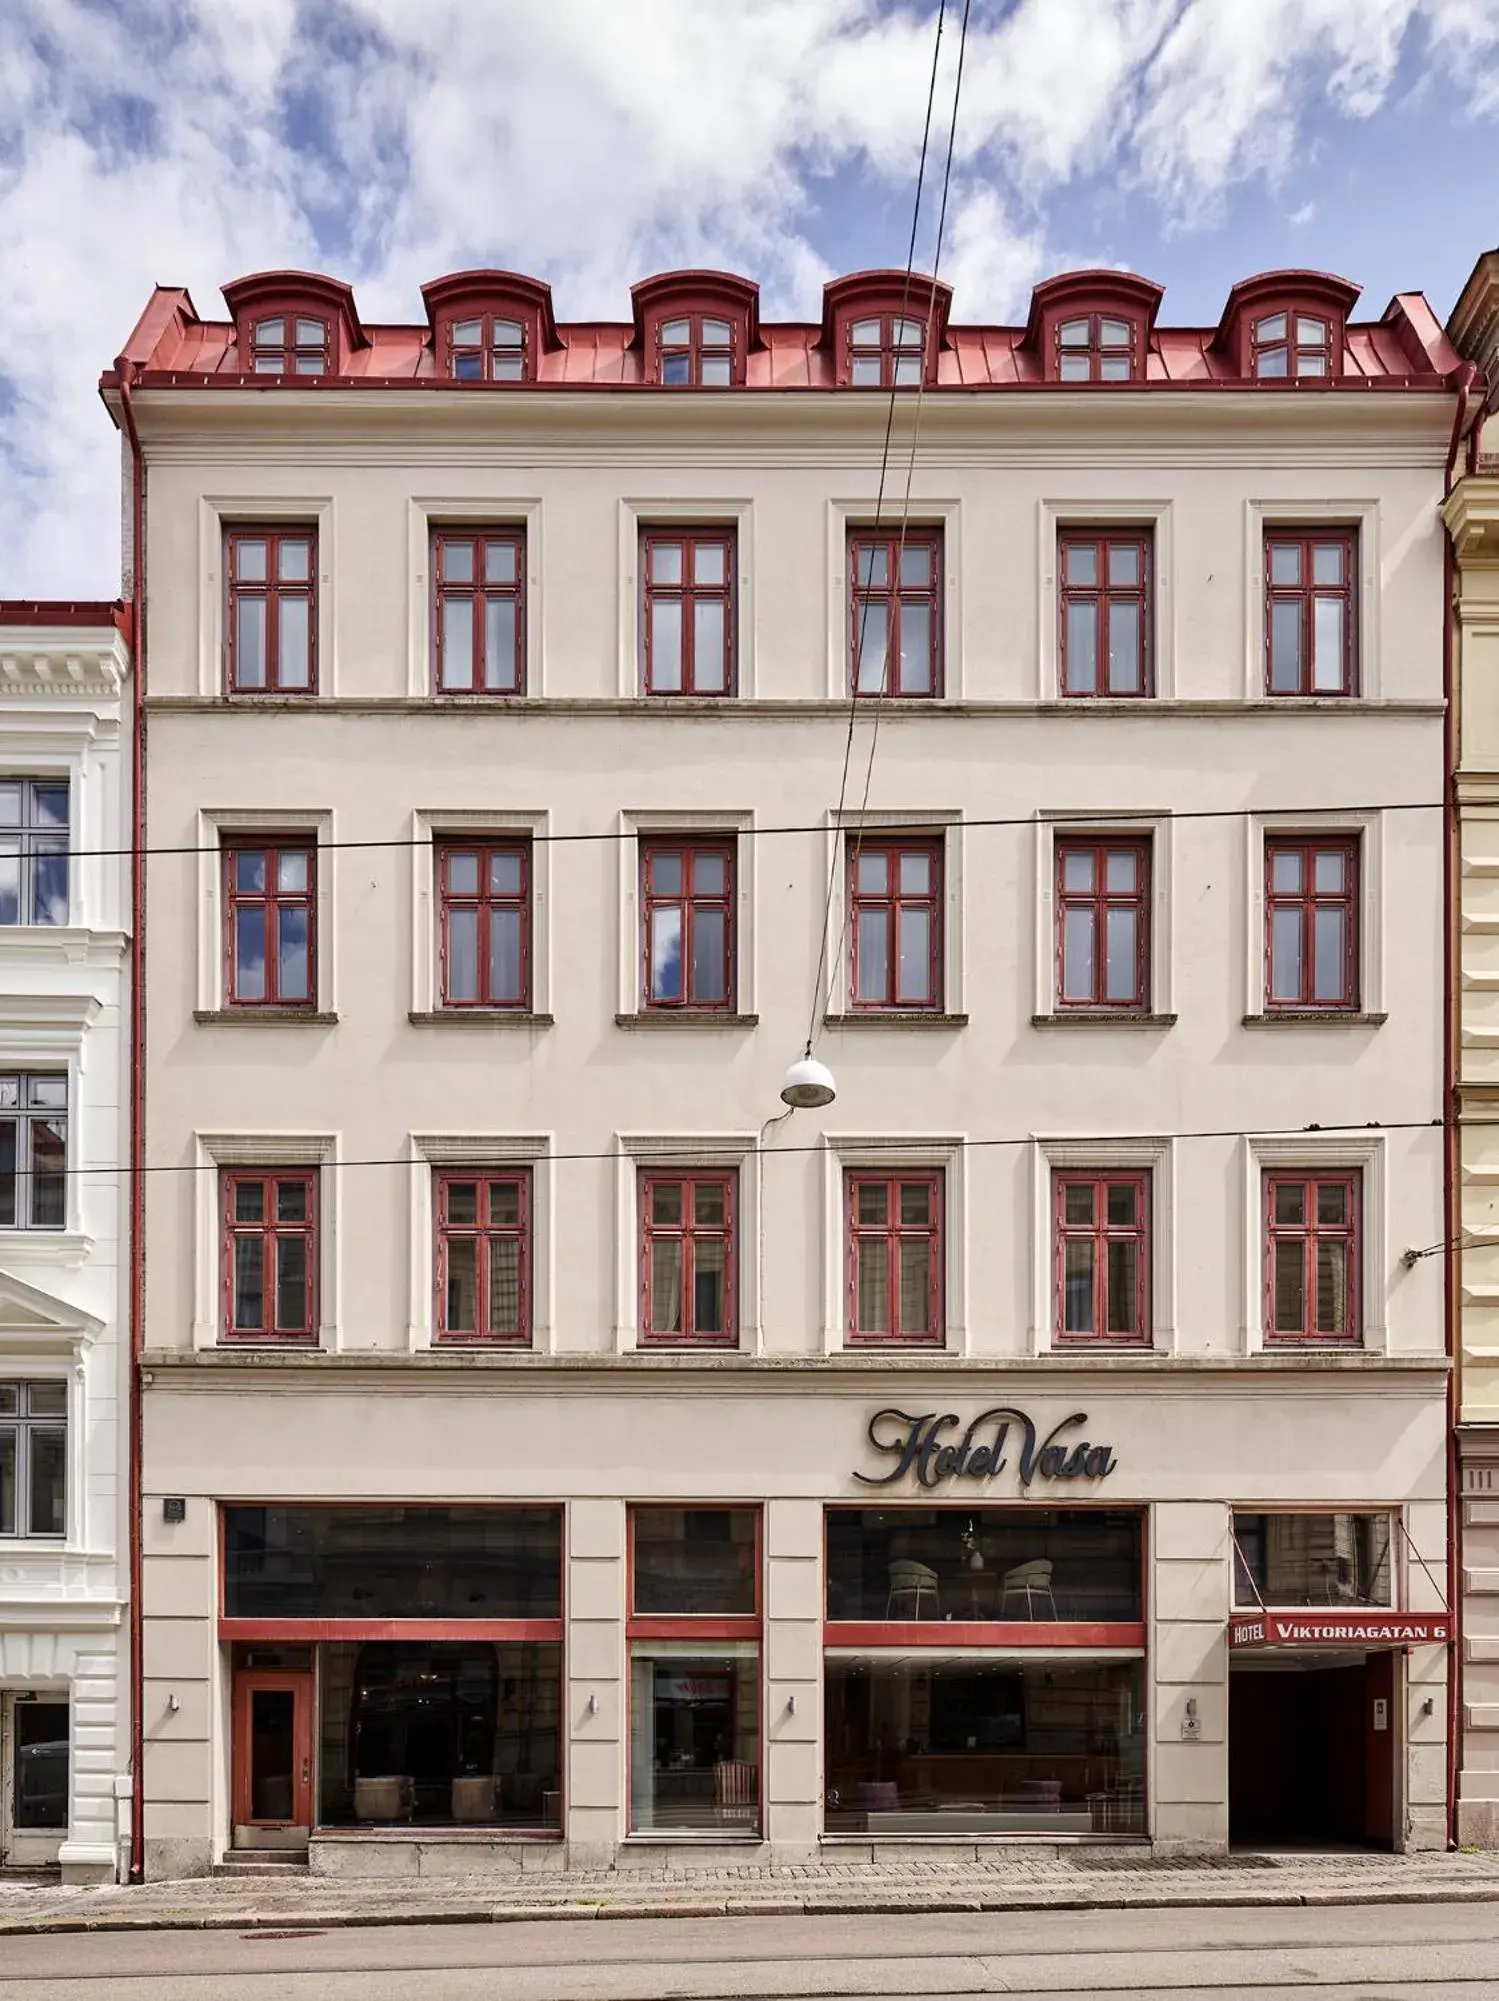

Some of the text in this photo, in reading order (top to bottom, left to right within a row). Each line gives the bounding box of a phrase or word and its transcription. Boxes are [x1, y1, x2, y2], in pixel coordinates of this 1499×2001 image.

[852, 1408, 1118, 1488] Hotel Vasa
[1234, 1622, 1265, 1644] HOTEL
[1275, 1623, 1447, 1638] VIKTORIAGATAN 6
